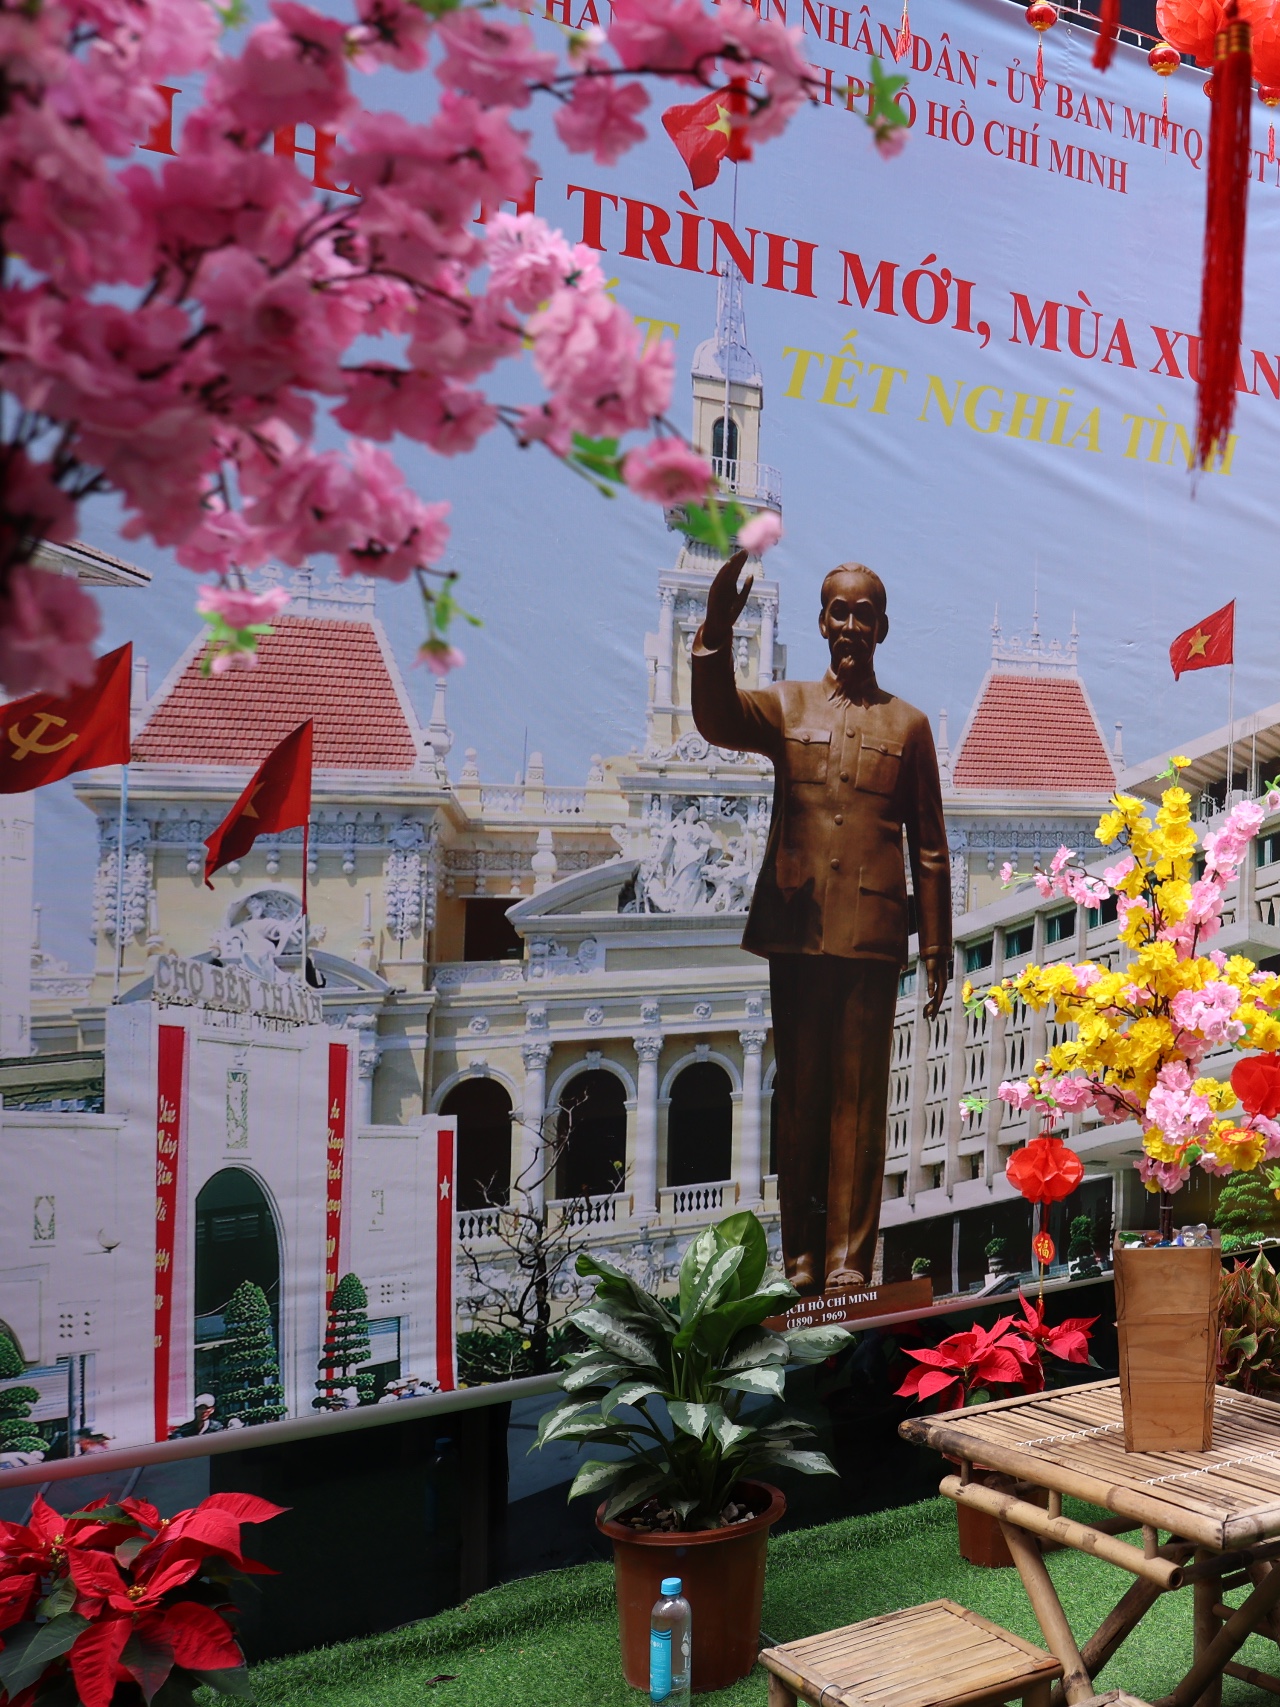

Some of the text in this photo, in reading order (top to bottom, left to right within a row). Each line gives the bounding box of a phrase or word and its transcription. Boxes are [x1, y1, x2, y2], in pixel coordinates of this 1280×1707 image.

[801, 1, 902, 64] NHÂN
[909, 33, 979, 89] DÂN
[1006, 58, 1048, 111] ỦY
[1056, 83, 1115, 133] BAN
[1122, 106, 1203, 169] MTTQ
[926, 99, 975, 146] HỒ
[983, 122, 1040, 168] CHÍ
[1049, 138, 1128, 194] MINH
[566, 184, 818, 298] TRÌNH
[837, 249, 991, 350] MỚI,
[1008, 290, 1138, 370] MÙA
[781, 329, 1240, 476] TẾT NGHĨA TÌNH
[808, 1291, 878, 1311] HỒ CHÍ MINH
[822, 1310, 847, 1323] 1969)
